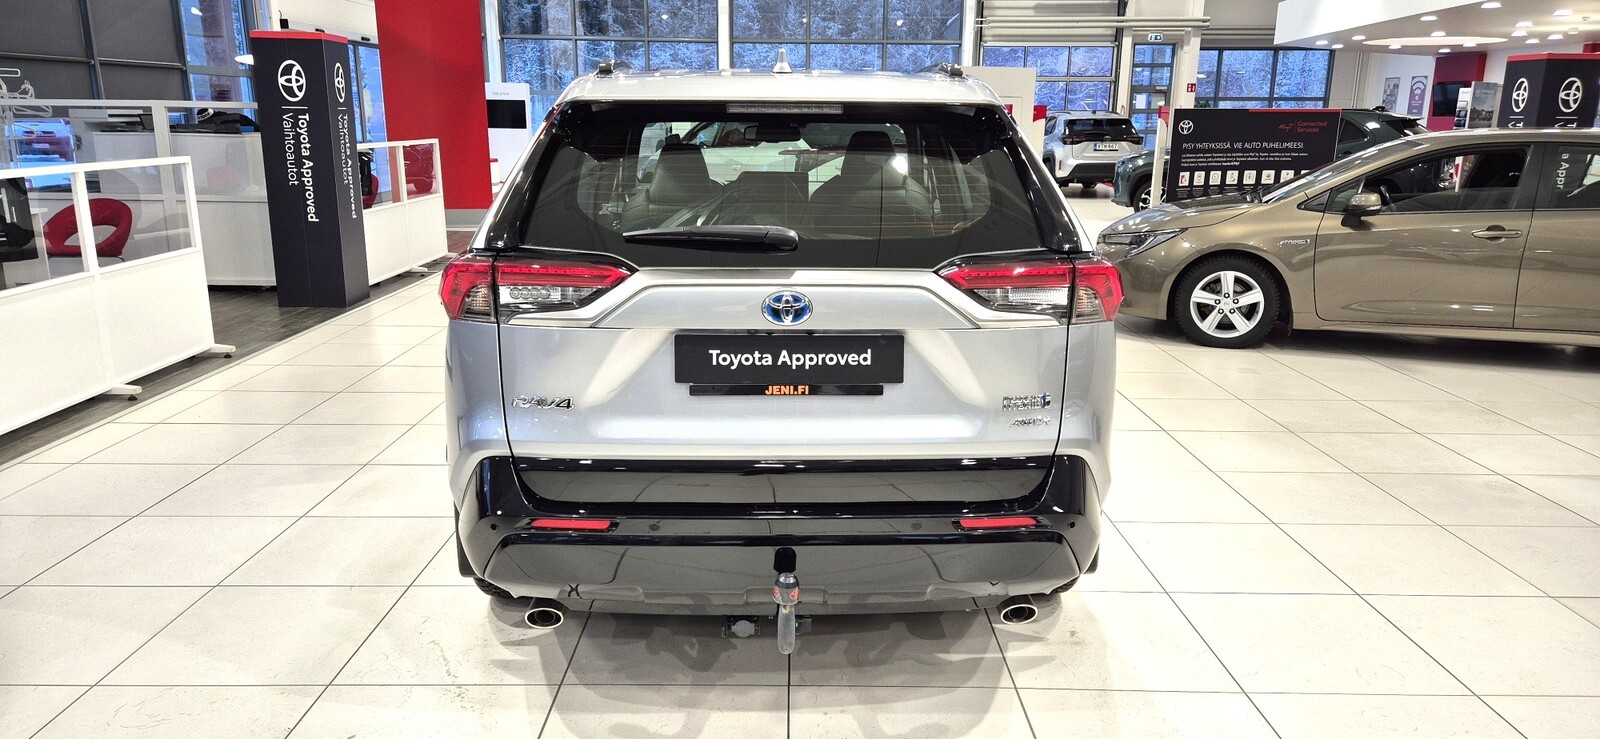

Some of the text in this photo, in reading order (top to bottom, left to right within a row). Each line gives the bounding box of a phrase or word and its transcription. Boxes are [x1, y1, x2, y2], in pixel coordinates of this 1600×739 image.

[282, 113, 298, 185] Vaihtoautot
[297, 113, 320, 222] Toyota Approved
[338, 114, 348, 184] Vaihtoautot
[342, 114, 357, 219] Toyota Approved
[709, 349, 872, 370] Toyota Approved
[764, 385, 809, 396] JENI.FI
[511, 395, 574, 410] RAV4
